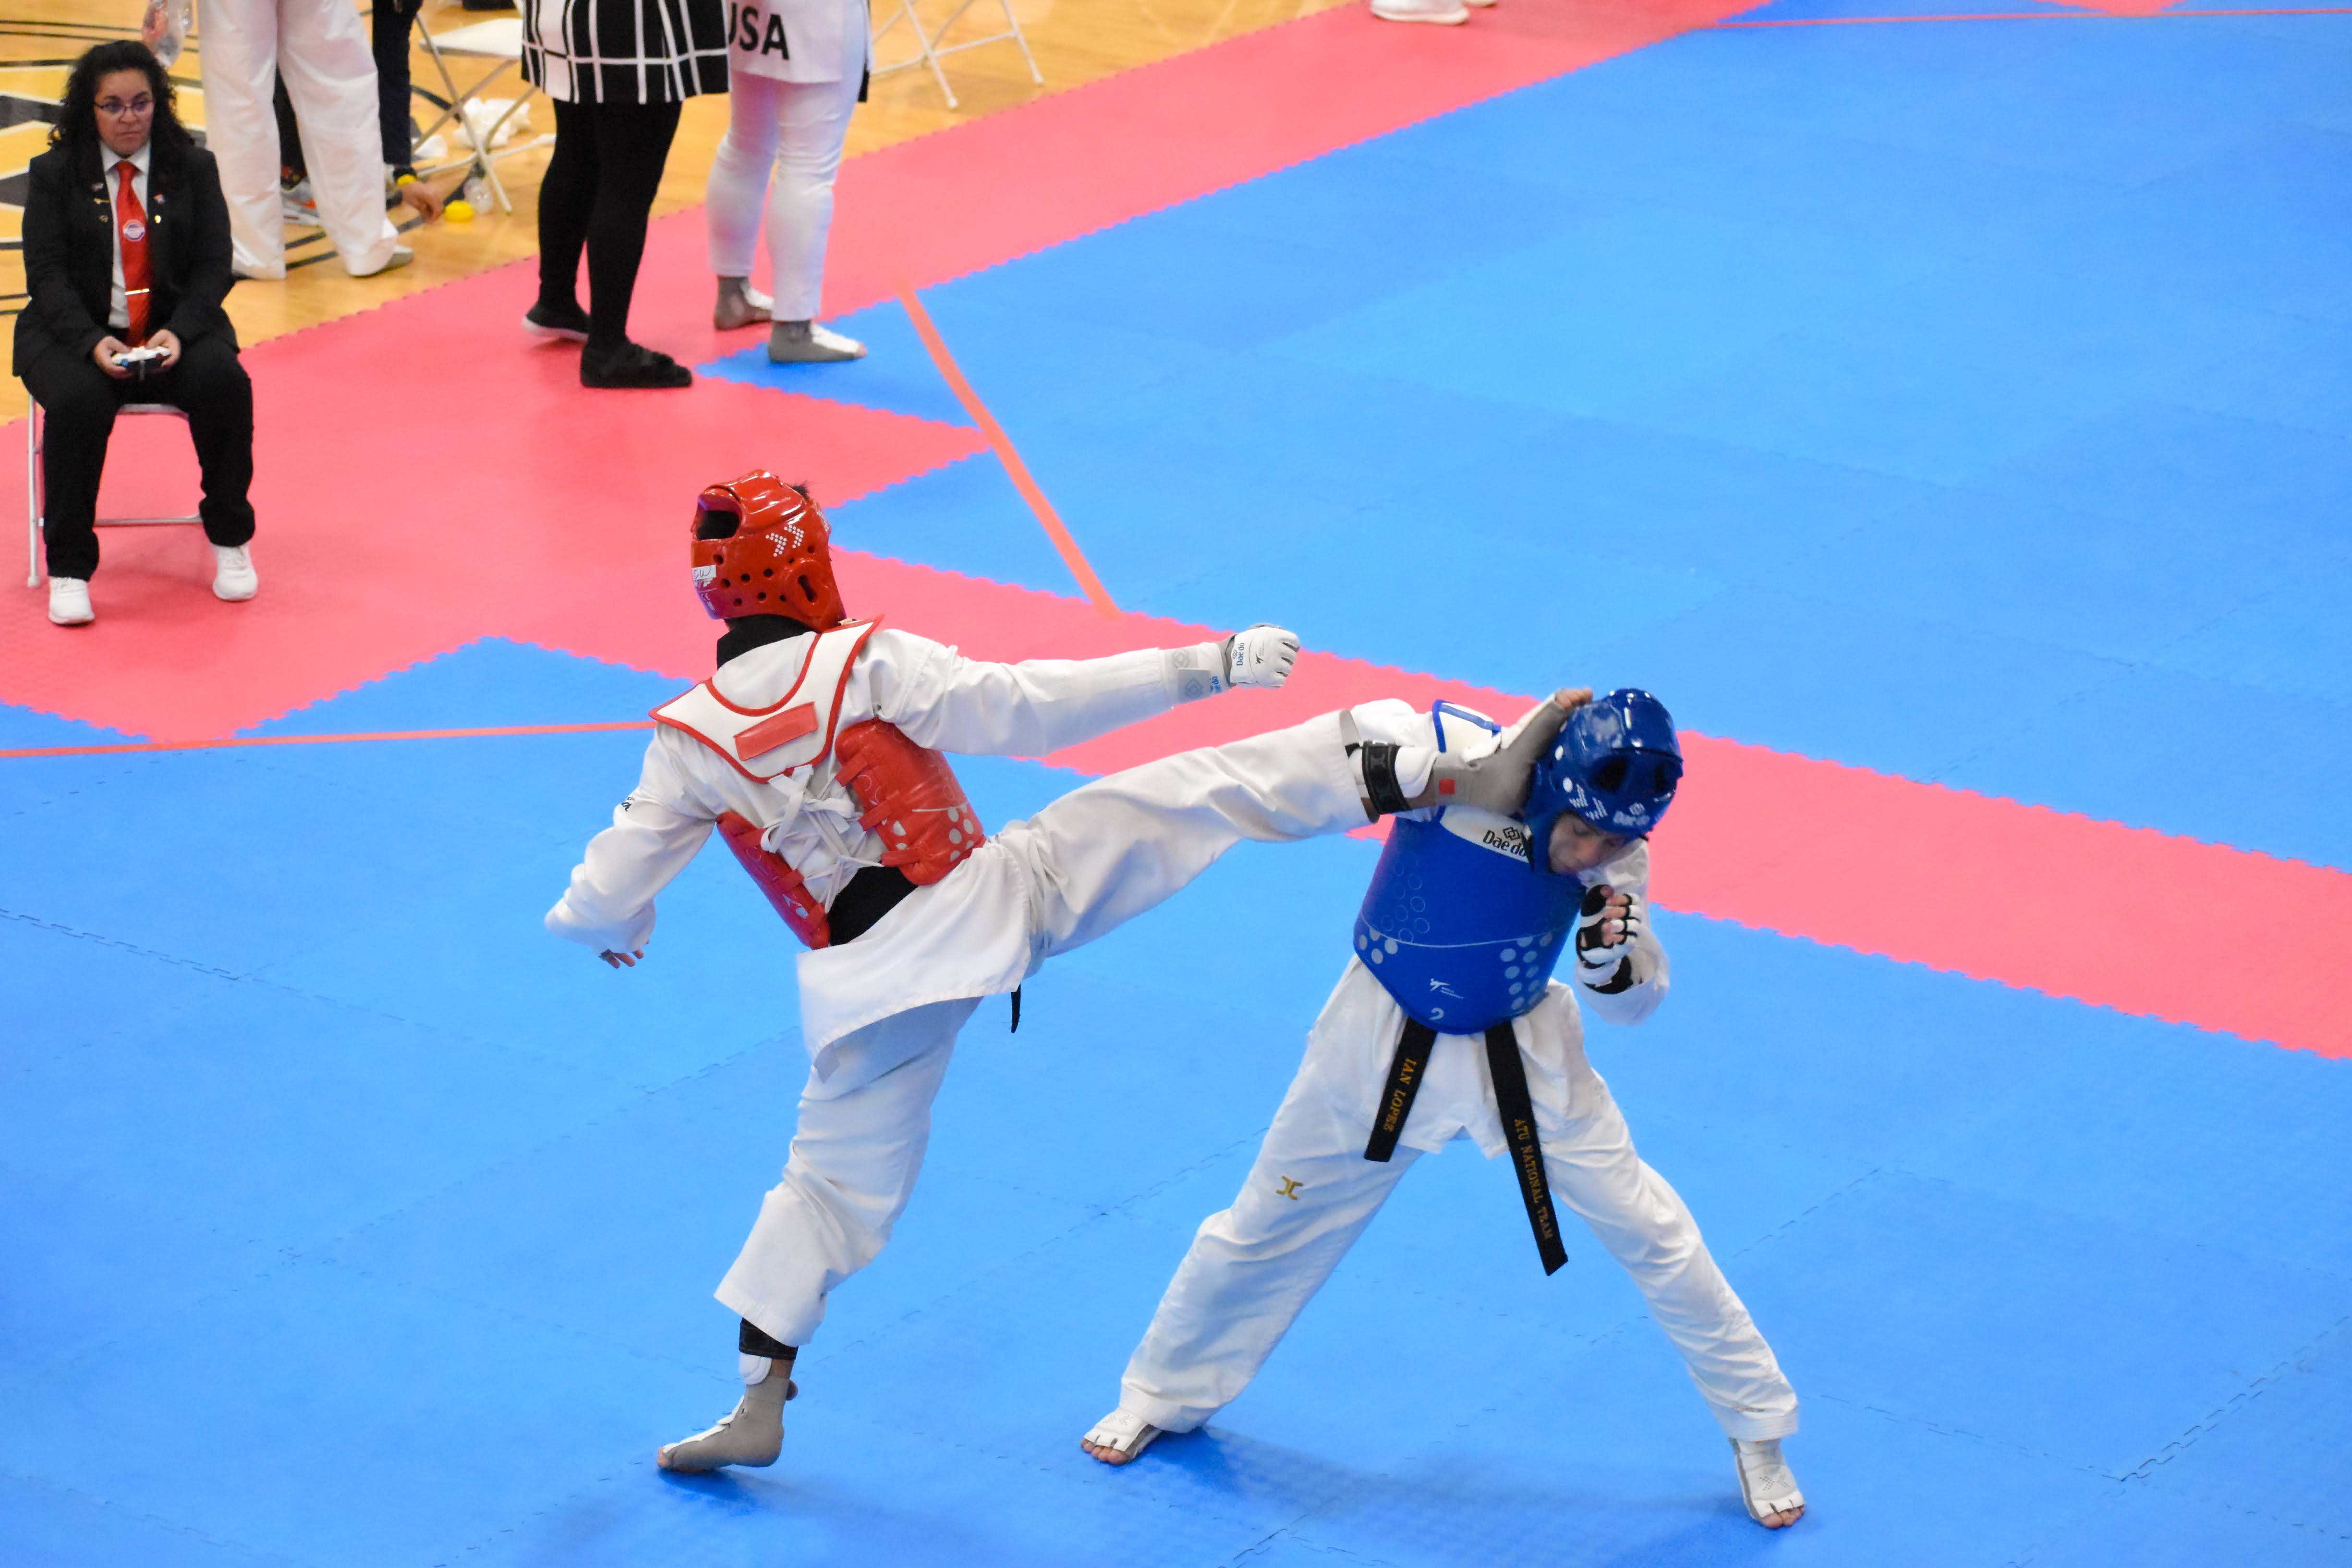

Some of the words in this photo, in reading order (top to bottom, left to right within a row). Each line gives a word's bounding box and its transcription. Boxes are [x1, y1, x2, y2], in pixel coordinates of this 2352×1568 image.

[1399, 1057, 1417, 1084] IAN
[1383, 1089, 1406, 1132] LOPEZ
[1515, 1118, 1530, 1141] ATU
[1521, 1144, 1544, 1204] NATIONAL
[1538, 1206, 1554, 1240] TEAM
